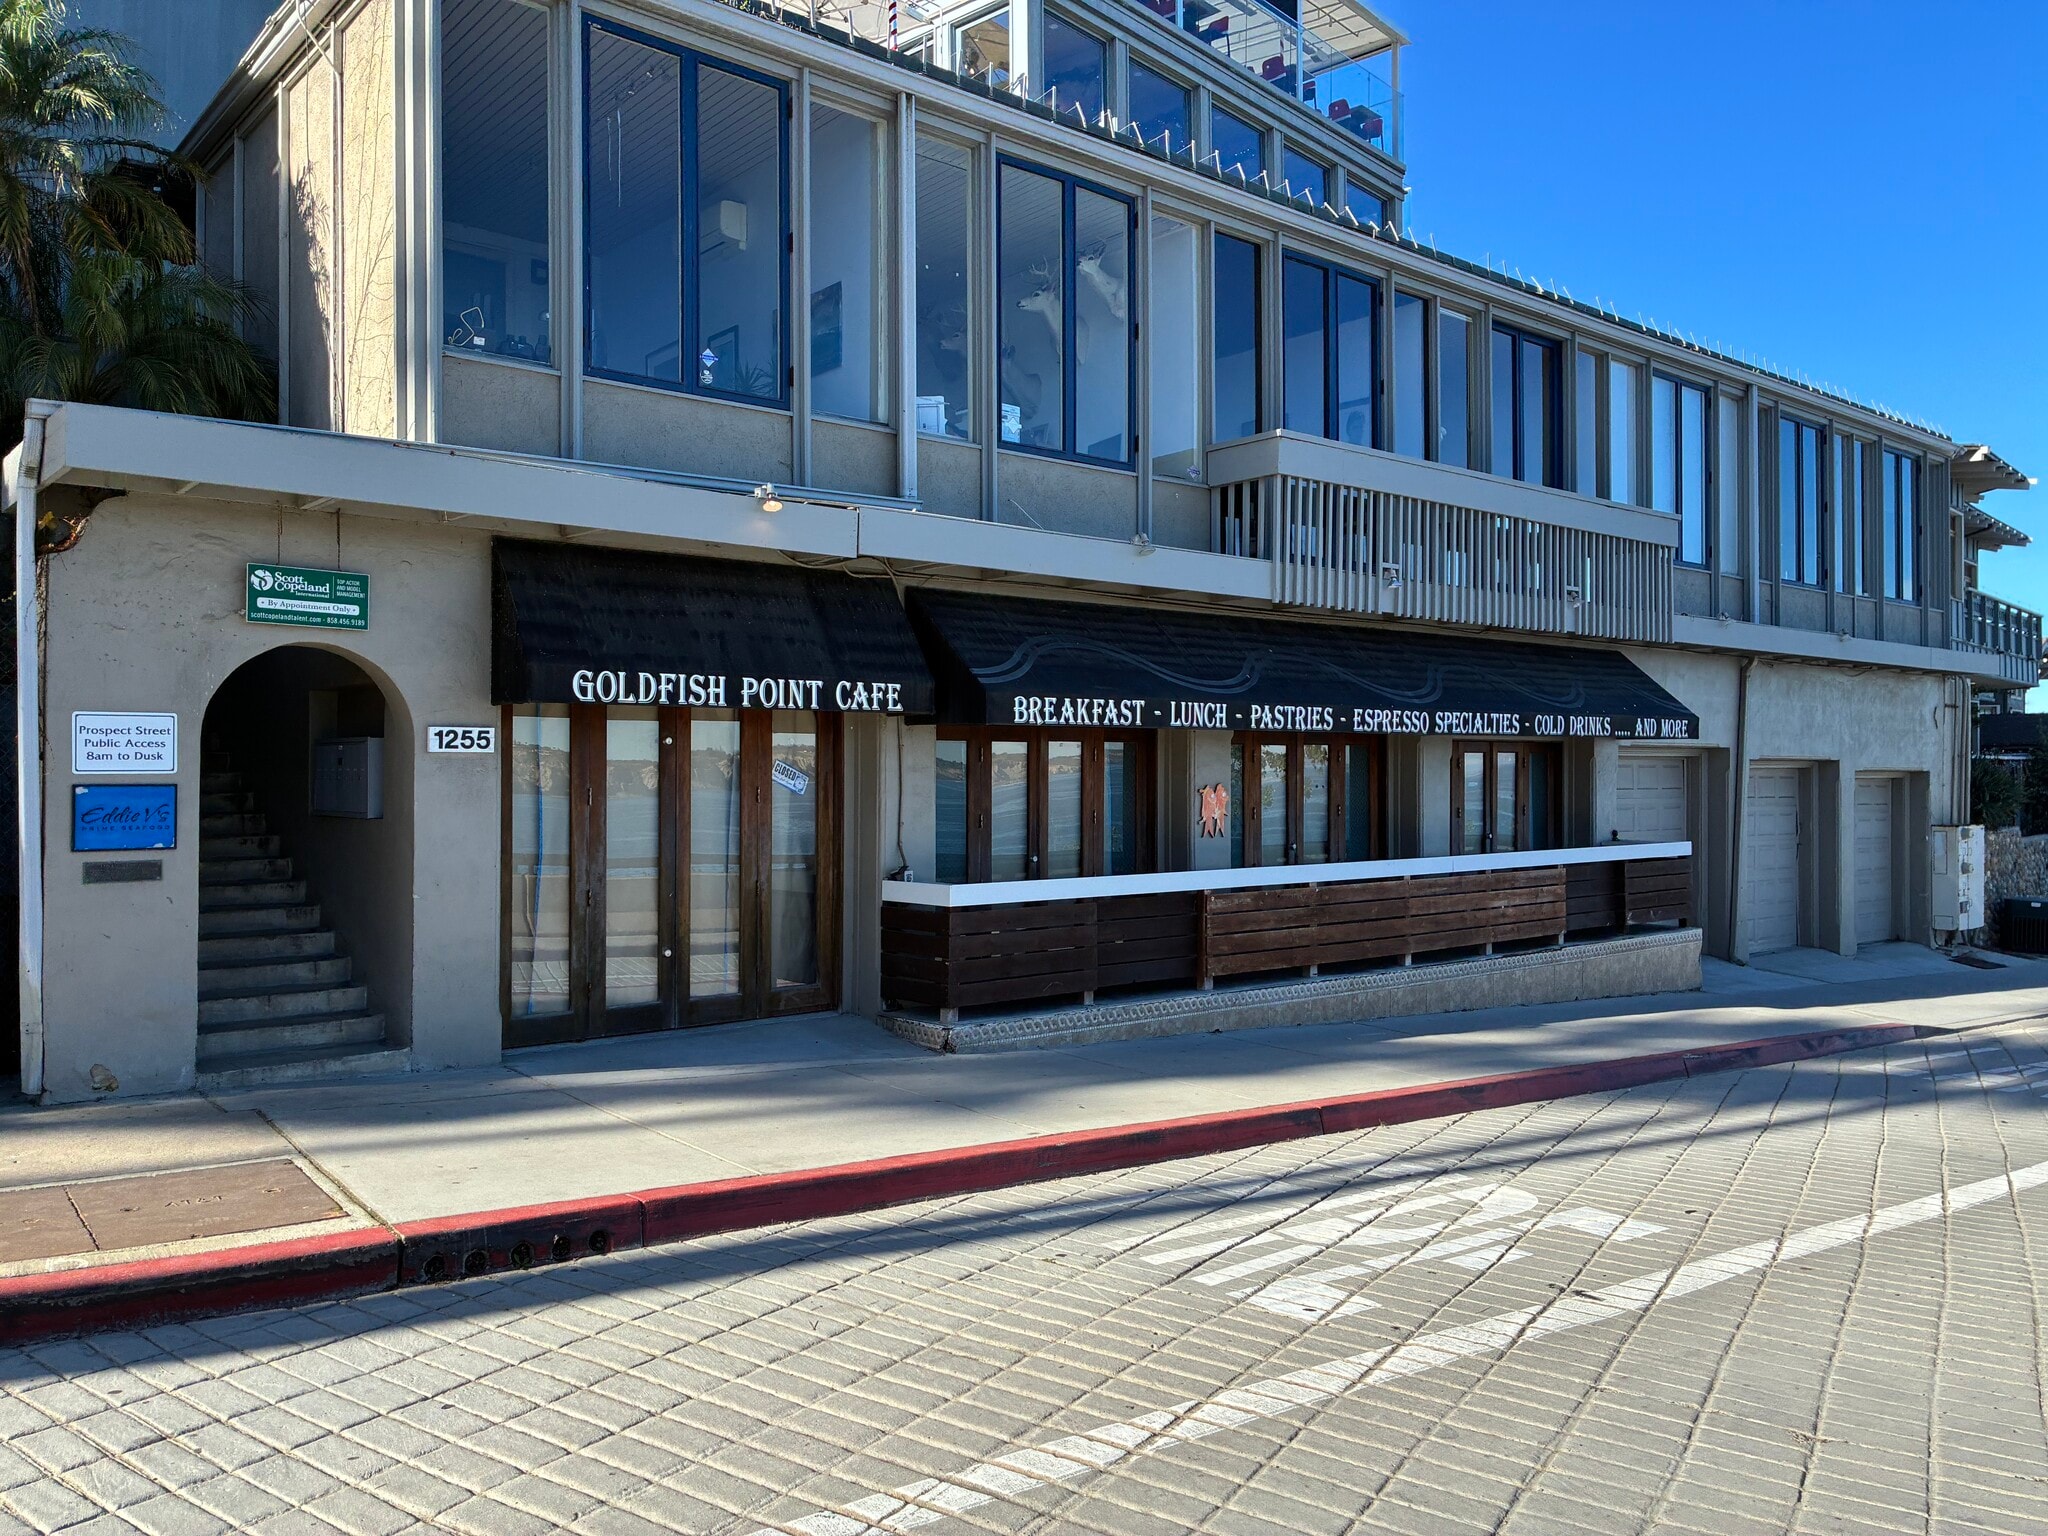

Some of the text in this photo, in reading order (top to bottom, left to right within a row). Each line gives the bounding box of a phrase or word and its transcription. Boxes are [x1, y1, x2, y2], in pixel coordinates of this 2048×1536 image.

[274, 571, 304, 584] Scott
[274, 581, 330, 594] Copeland
[336, 591, 365, 599] MANAGEMENT
[279, 600, 330, 611] Appointment
[332, 605, 351, 613] Only
[250, 612, 322, 623] scottcopelandtalent.com
[326, 618, 365, 627] 858.456.9189
[572, 669, 904, 712] GOLDFISH POINT CAFE
[1013, 695, 1145, 726] BREAKFAST
[1170, 701, 1228, 728] LUNCH
[1250, 704, 1334, 732] PASTRIES
[1353, 708, 1430, 734] ESPRESSO
[1434, 711, 1520, 735] SPECIALTIES
[1534, 714, 1565, 735] COLD
[1569, 716, 1611, 737] DRINKS
[1634, 718, 1657, 737] AND
[1660, 719, 1689, 739] MORE
[79, 726, 171, 736] Prospect Street
[84, 739, 166, 748] Public Access
[434, 729, 491, 750] 1255
[86, 751, 164, 761] 8am to Dusk
[774, 762, 797, 781] CLOSED
[80, 803, 170, 825] Eddie V's
